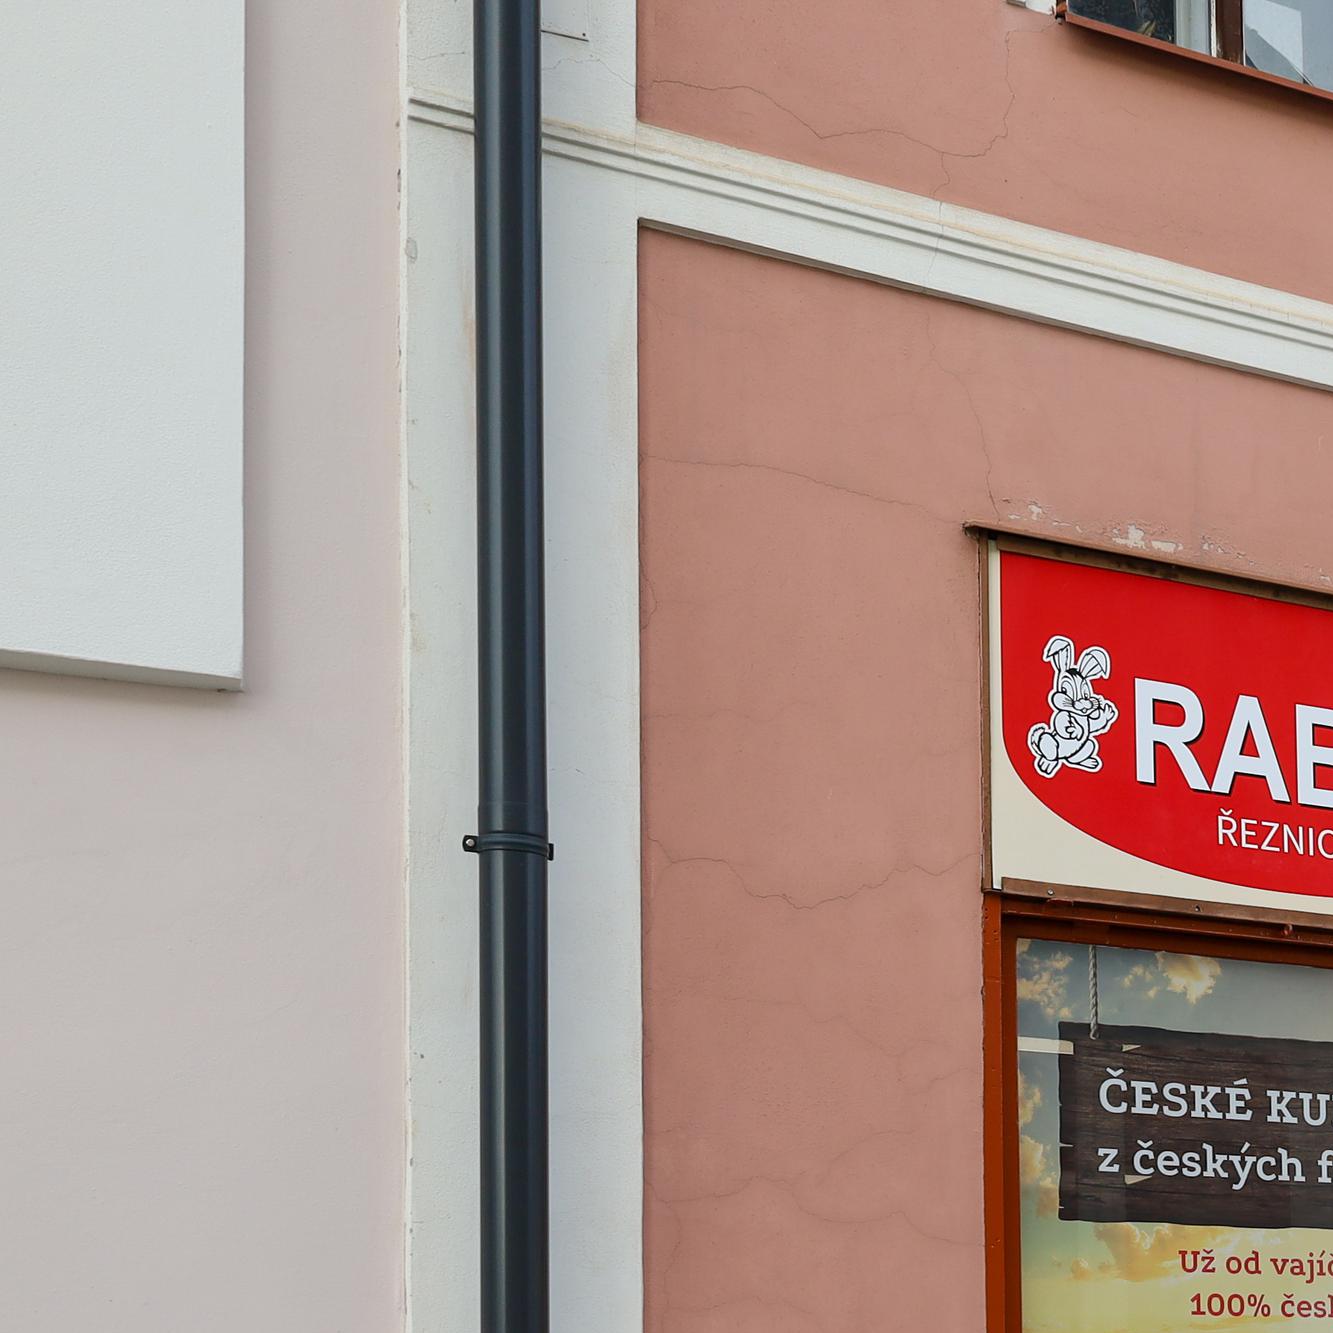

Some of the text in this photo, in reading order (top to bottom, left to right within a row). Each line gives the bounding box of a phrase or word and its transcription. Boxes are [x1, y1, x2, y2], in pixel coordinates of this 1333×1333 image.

[1099, 1066, 1253, 1122] ČESKÉ
[1097, 1147, 1120, 1174] z
[1133, 1139, 1306, 1191] českých
[1179, 1249, 1216, 1274] Už
[1225, 1251, 1262, 1276] od
[1190, 1293, 1271, 1318] 100%
